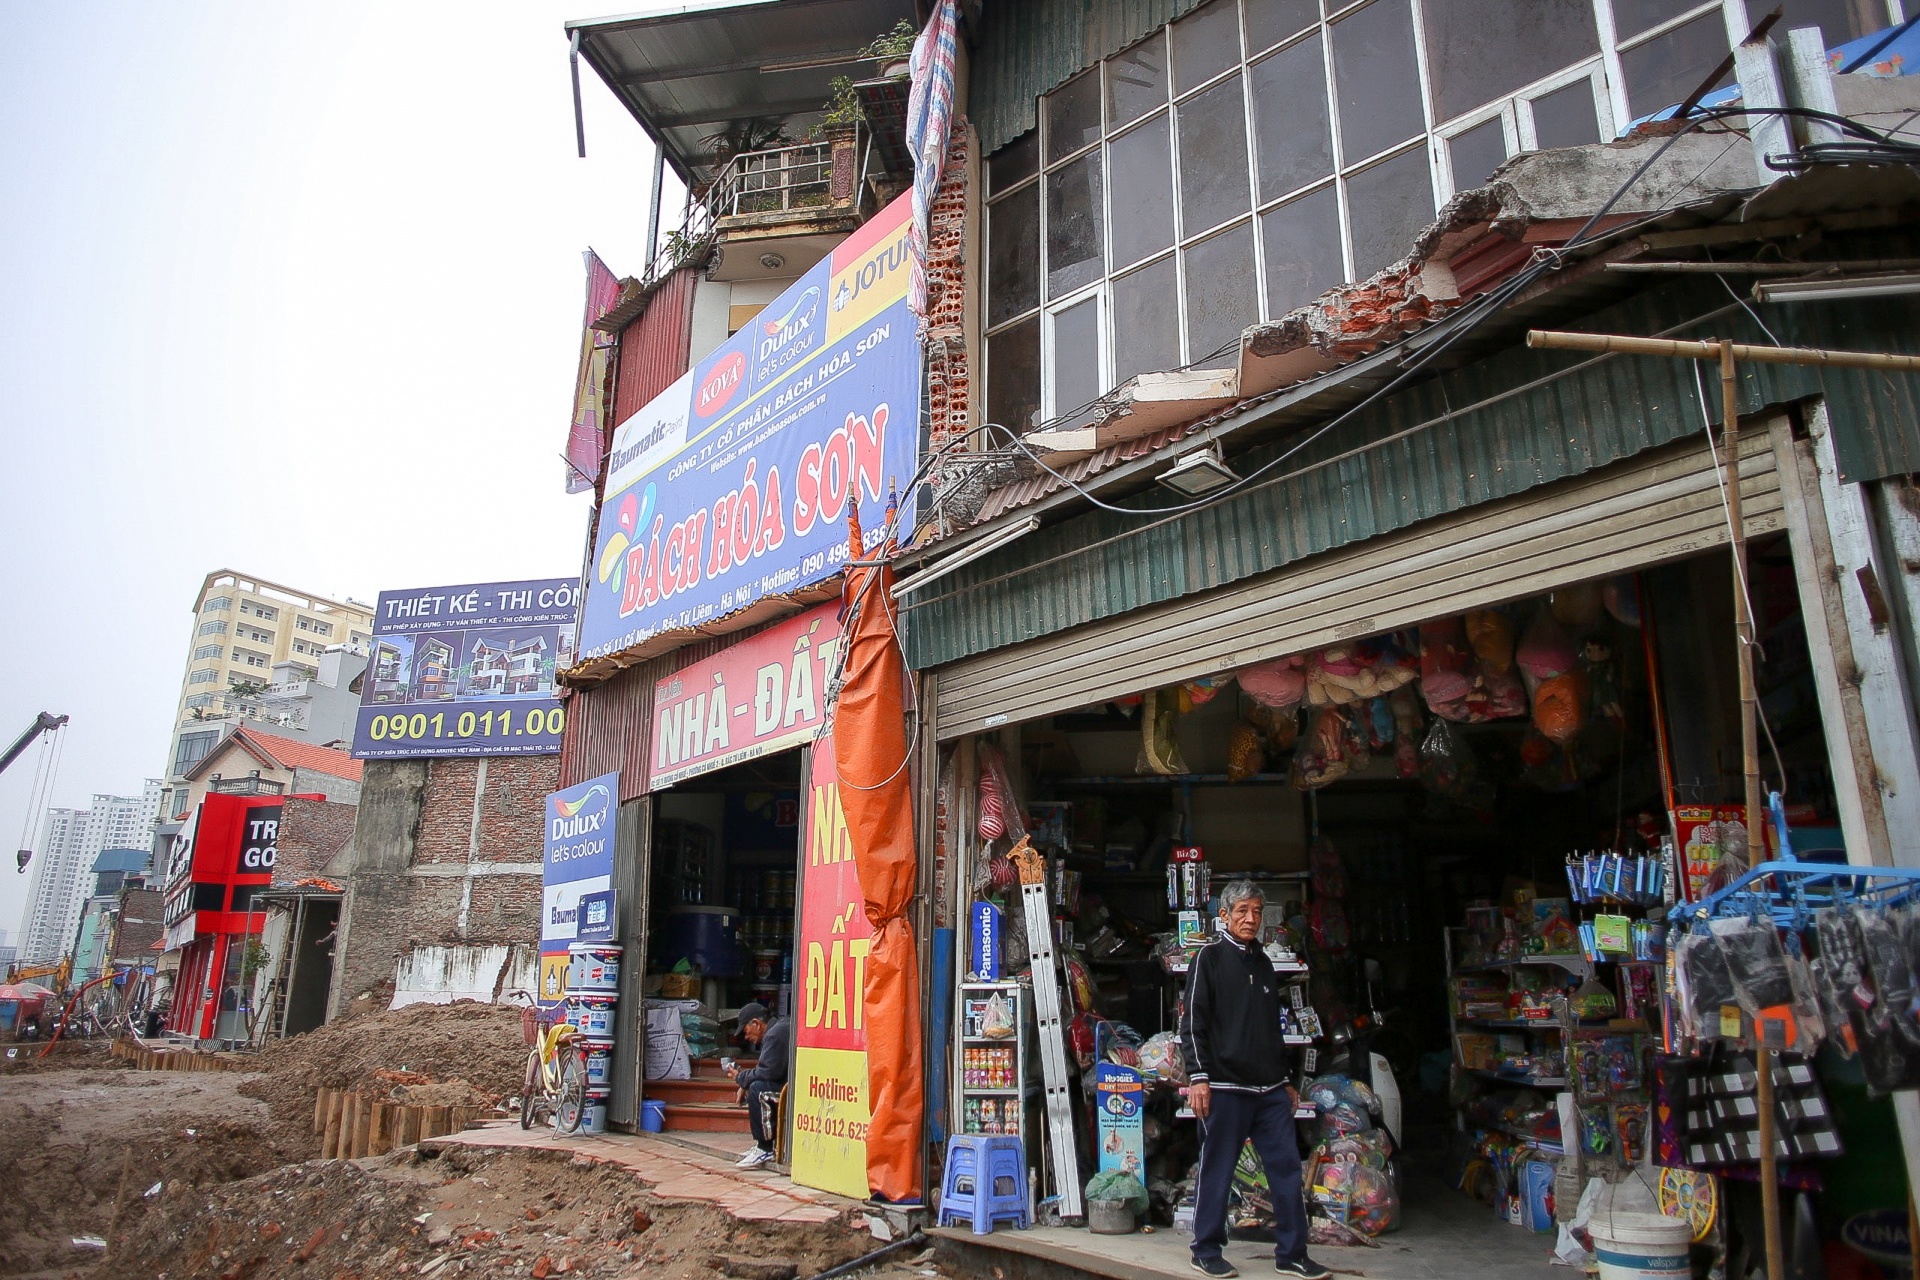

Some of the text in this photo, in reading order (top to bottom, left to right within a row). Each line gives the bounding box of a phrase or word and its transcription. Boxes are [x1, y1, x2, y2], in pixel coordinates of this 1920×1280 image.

[757, 330, 815, 382] let's colour
[760, 311, 810, 362] Dulux
[667, 454, 698, 482] CÔNG
[700, 441, 715, 461] TY
[717, 421, 735, 449] CỔ
[736, 404, 771, 437] PHẦN
[774, 373, 814, 411] BÁCH
[818, 349, 851, 382] HÓA
[855, 322, 890, 357] SƠN
[610, 419, 667, 476] Baumatic
[710, 450, 737, 475] Website:
[738, 393, 827, 457] www.bachhoason.com.vn
[619, 402, 889, 619] BÁCH HÓA SƠN
[385, 591, 446, 618] THIẾT
[449, 588, 480, 614] KẾ
[497, 589, 533, 611] THI
[662, 613, 677, 630] Bắc
[680, 610, 692, 627] Từ
[692, 603, 713, 623] Liêm
[721, 590, 733, 611] Hà
[735, 583, 751, 606] Nội
[761, 565, 800, 594] Hotline:
[802, 551, 824, 577] 090
[826, 540, 850, 565] 496
[392, 622, 409, 631] PHÉP
[409, 620, 422, 629] XÂY
[422, 620, 441, 629] DỰNG
[513, 613, 533, 623] CÔNG
[550, 612, 568, 621] TRÚC
[658, 671, 730, 769] NHÀ
[754, 617, 841, 738] ĐẤT
[551, 837, 606, 863] let's colour
[552, 812, 600, 841] Dulux
[812, 781, 857, 867] NH
[805, 902, 871, 1030] ĐẤT
[979, 906, 991, 980] Panasonic
[809, 1075, 858, 1103] Hotline:
[797, 1113, 869, 1141] 0912 012 625
[1647, 1257, 1678, 1269] valspar
